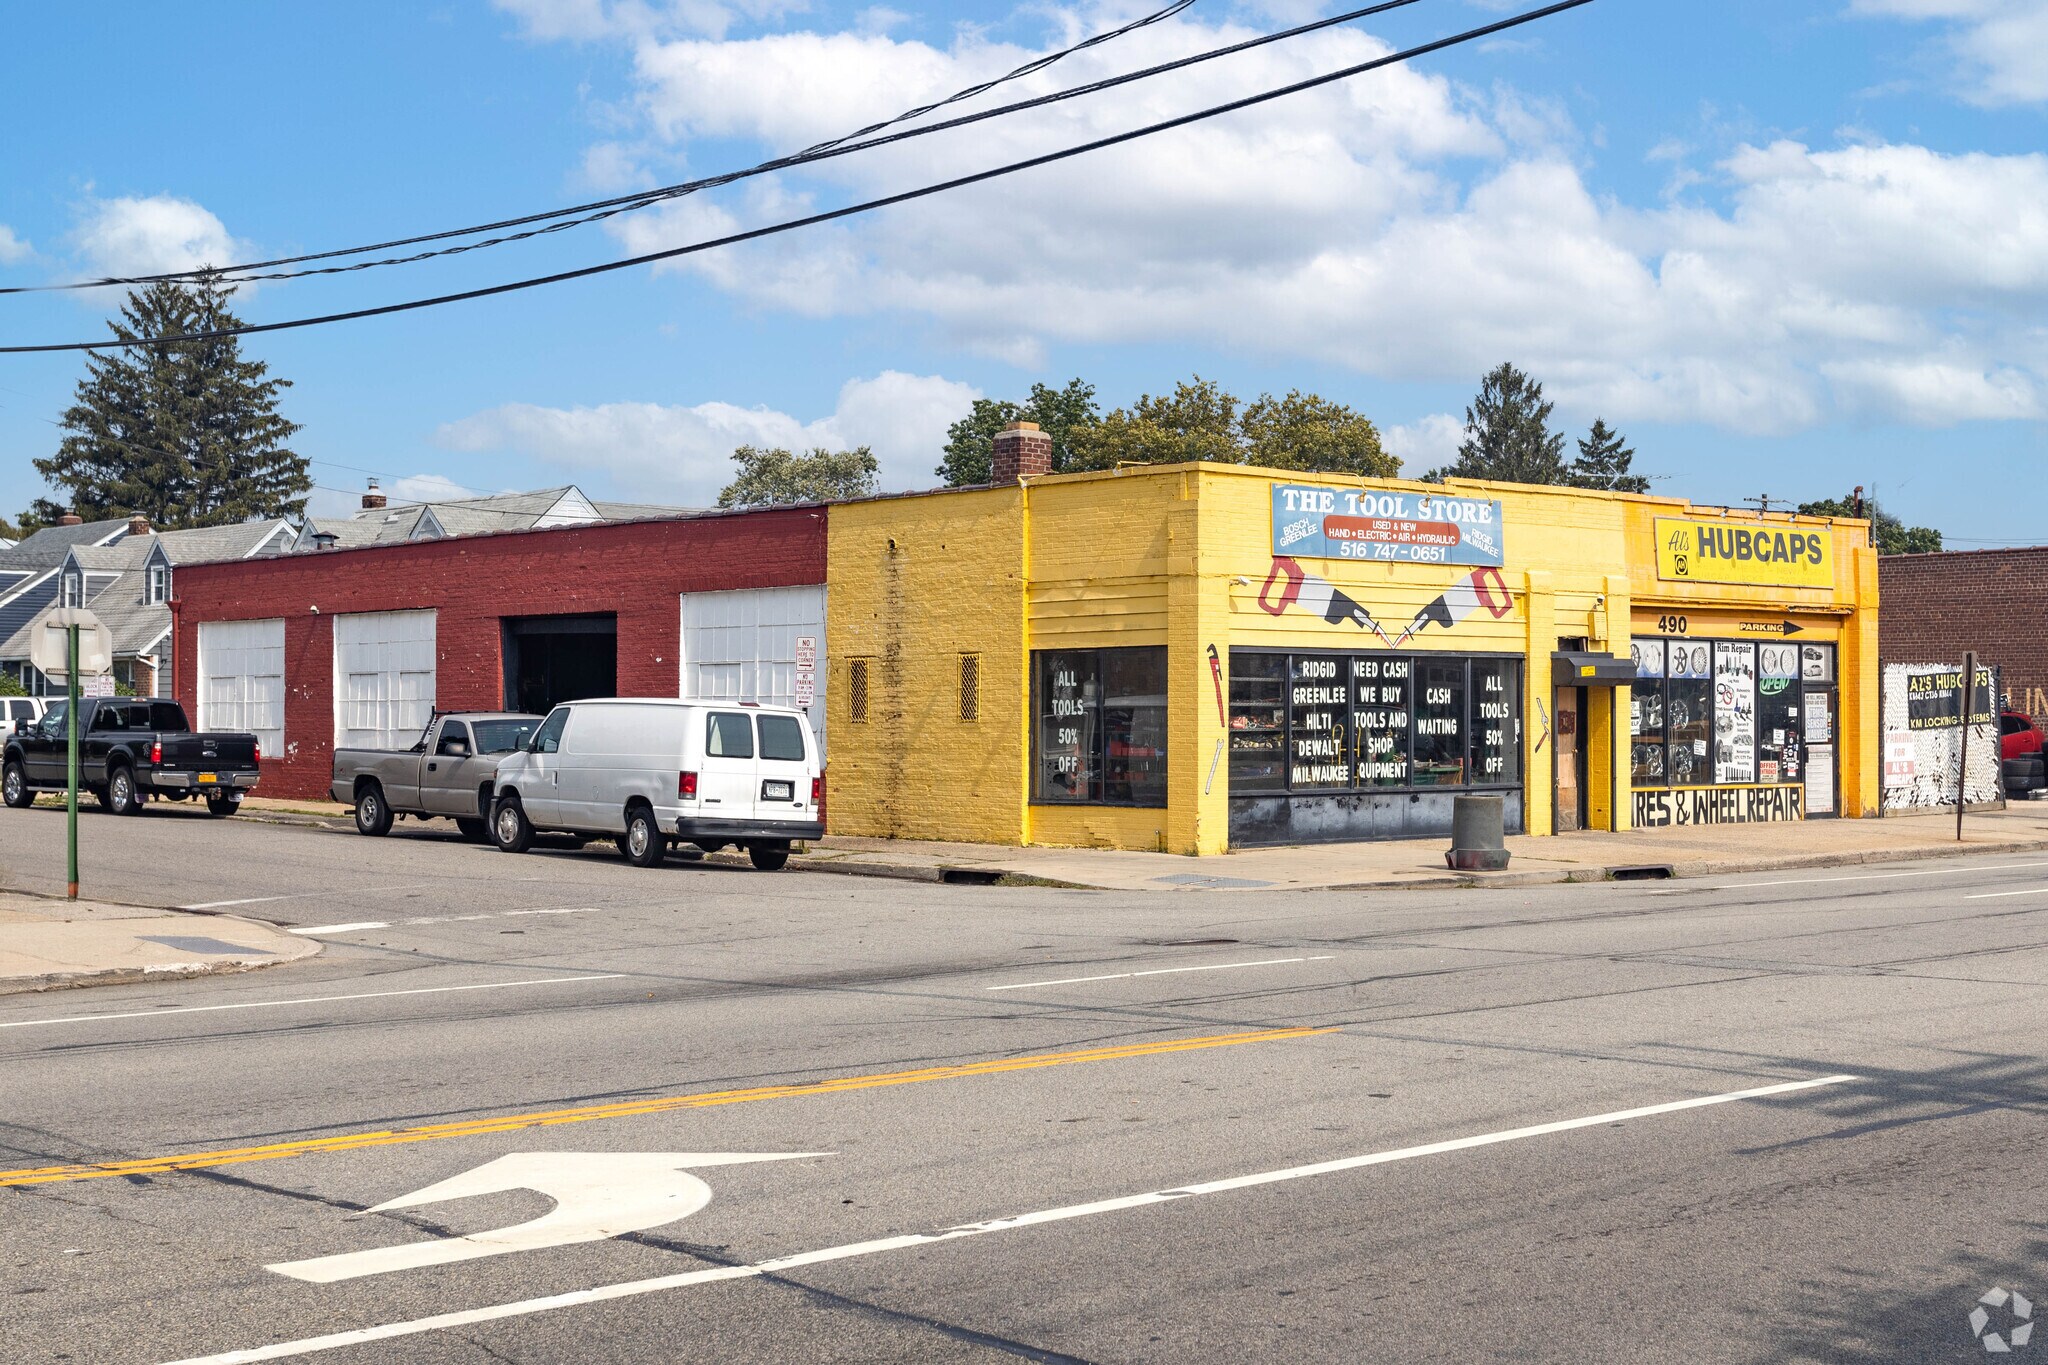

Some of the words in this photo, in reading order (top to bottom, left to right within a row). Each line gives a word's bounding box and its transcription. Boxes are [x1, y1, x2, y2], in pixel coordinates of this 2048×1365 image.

[1282, 489, 1335, 513] THE
[1345, 493, 1409, 519] TOOL
[1418, 499, 1493, 524] STORE
[1283, 517, 1310, 536] BOSCH
[1372, 520, 1391, 530] USED
[1394, 522, 1398, 530] &
[1400, 522, 1416, 532] NEW
[1280, 523, 1318, 547] GREENLEE
[1328, 528, 1350, 538] HAND
[1358, 530, 1392, 541] ELECTRIC
[1398, 532, 1411, 542] AIR
[1417, 534, 1456, 545] HYDRAULIC
[1471, 528, 1493, 546] RIDGID
[1668, 530, 1690, 551] Al's
[1340, 542, 1367, 558] 516
[1461, 532, 1499, 558] MILWAUKEE
[1697, 526, 1823, 565] HUBCAPS
[1658, 615, 1687, 634] 490
[1740, 622, 1784, 632] PARKING
[1717, 642, 1730, 652] Rim
[1731, 643, 1752, 656] Repair
[1302, 661, 1336, 678] RIDGID
[1353, 662, 1378, 678] NEED
[1383, 662, 1408, 678] CASH
[1058, 670, 1077, 686] ALL
[1486, 676, 1503, 691] ALL
[1761, 678, 1787, 690] OPEN
[1910, 676, 1932, 692] AL'S
[1936, 672, 1988, 689] HUBCPS
[1292, 687, 1346, 704] GREENLEE
[1360, 686, 1376, 702] WE
[1382, 687, 1402, 703] BUY
[1426, 688, 1450, 704] CASH
[1052, 699, 1084, 716] TOOLS
[1480, 702, 1509, 718] TOOLS
[1306, 713, 1332, 730] HILTI
[1354, 712, 1386, 728] TOOLS
[1388, 712, 1408, 728] AND
[1418, 718, 1457, 735] WAITING
[1910, 718, 1922, 729] KM
[1924, 716, 1958, 728] LOCKING
[1960, 713, 1990, 724] SSTEMS
[1058, 728, 1078, 744] 50%
[1486, 730, 1503, 746] 50%
[1886, 732, 1913, 744] PARKING
[1298, 740, 1341, 756] DEWALT
[1368, 738, 1394, 754] SHOP
[1894, 748, 1906, 757] FOR
[1058, 756, 1078, 772] OFF
[1486, 758, 1503, 773] OFF
[1892, 761, 1908, 773] AL'S
[1292, 766, 1349, 783] MILWAUKEE
[1676, 790, 1690, 825] &
[1693, 789, 1746, 825] WHEEL
[1747, 788, 1800, 822] REPAIR
